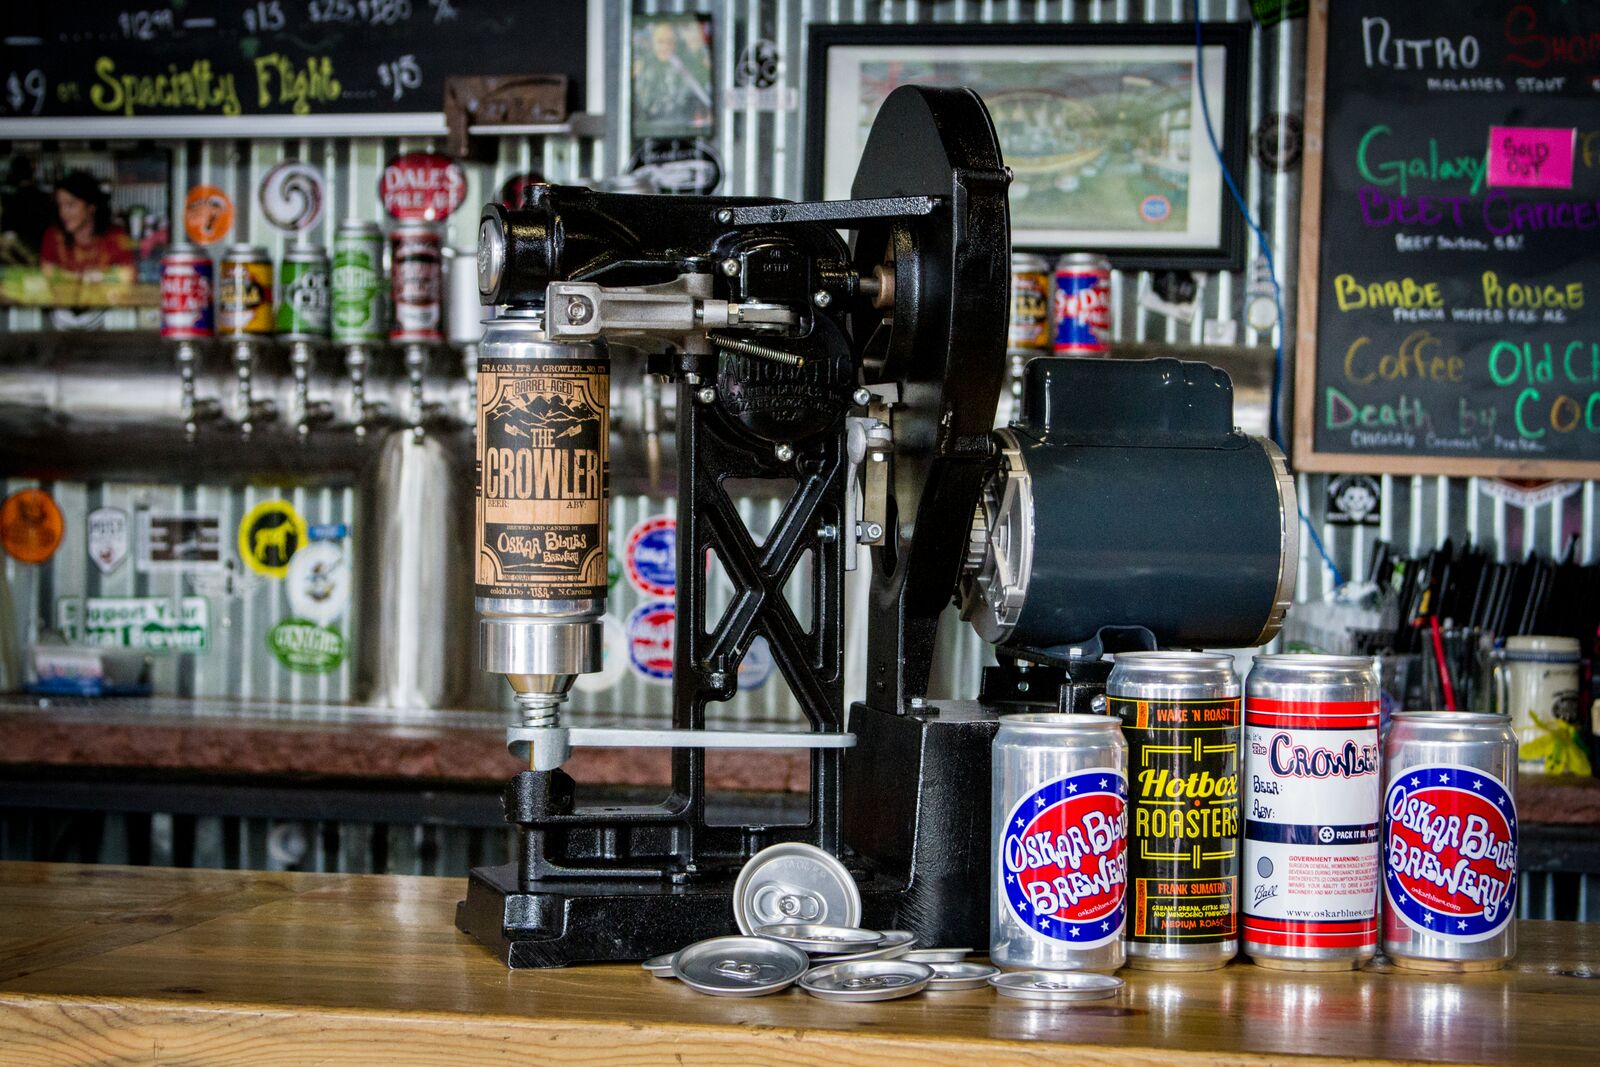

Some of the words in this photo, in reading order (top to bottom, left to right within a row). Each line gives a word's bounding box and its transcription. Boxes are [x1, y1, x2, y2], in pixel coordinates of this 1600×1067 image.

[1362, 16, 1480, 69] NITRO
[90, 56, 241, 116] Specialty
[255, 53, 341, 114] Flight
[1356, 124, 1488, 196] Galaxy
[1334, 274, 1444, 312] BARBE
[1482, 270, 1585, 310] ROUGE
[516, 364, 531, 372] IT'S
[534, 364, 540, 372] A
[1344, 330, 1465, 385] Coffee
[1488, 340, 1554, 386] Old
[515, 379, 572, 395] BARREL-AGED
[1326, 386, 1432, 430] Death
[1459, 398, 1497, 437] by
[531, 428, 555, 448] THE
[487, 447, 598, 499] CROWLER
[567, 501, 586, 509] ABV:
[497, 532, 541, 559] OSKAR
[544, 532, 586, 550] BLUES
[543, 551, 578, 564] BREWERY
[531, 587, 549, 598] USA
[1156, 709, 1188, 721] WAKE
[1192, 709, 1200, 721] 'N
[1204, 708, 1230, 721] ROAST
[1138, 769, 1238, 797] Hotbox
[1136, 806, 1238, 838] ROASTERS
[1389, 785, 1461, 853] OSKAR
[1336, 831, 1353, 839] PACK
[1354, 831, 1359, 839] IT
[1005, 825, 1090, 873] OSKAR
[1026, 846, 1128, 916] BREWER
[1158, 883, 1188, 895] FRANK
[1191, 882, 1226, 895] SUMATRA
[1390, 834, 1505, 922] BREWERY
[1254, 884, 1278, 901] Ball
[1411, 887, 1461, 912] oskarblues.com
[1161, 919, 1197, 929] MEDIUM
[1200, 918, 1224, 927] ROAST
